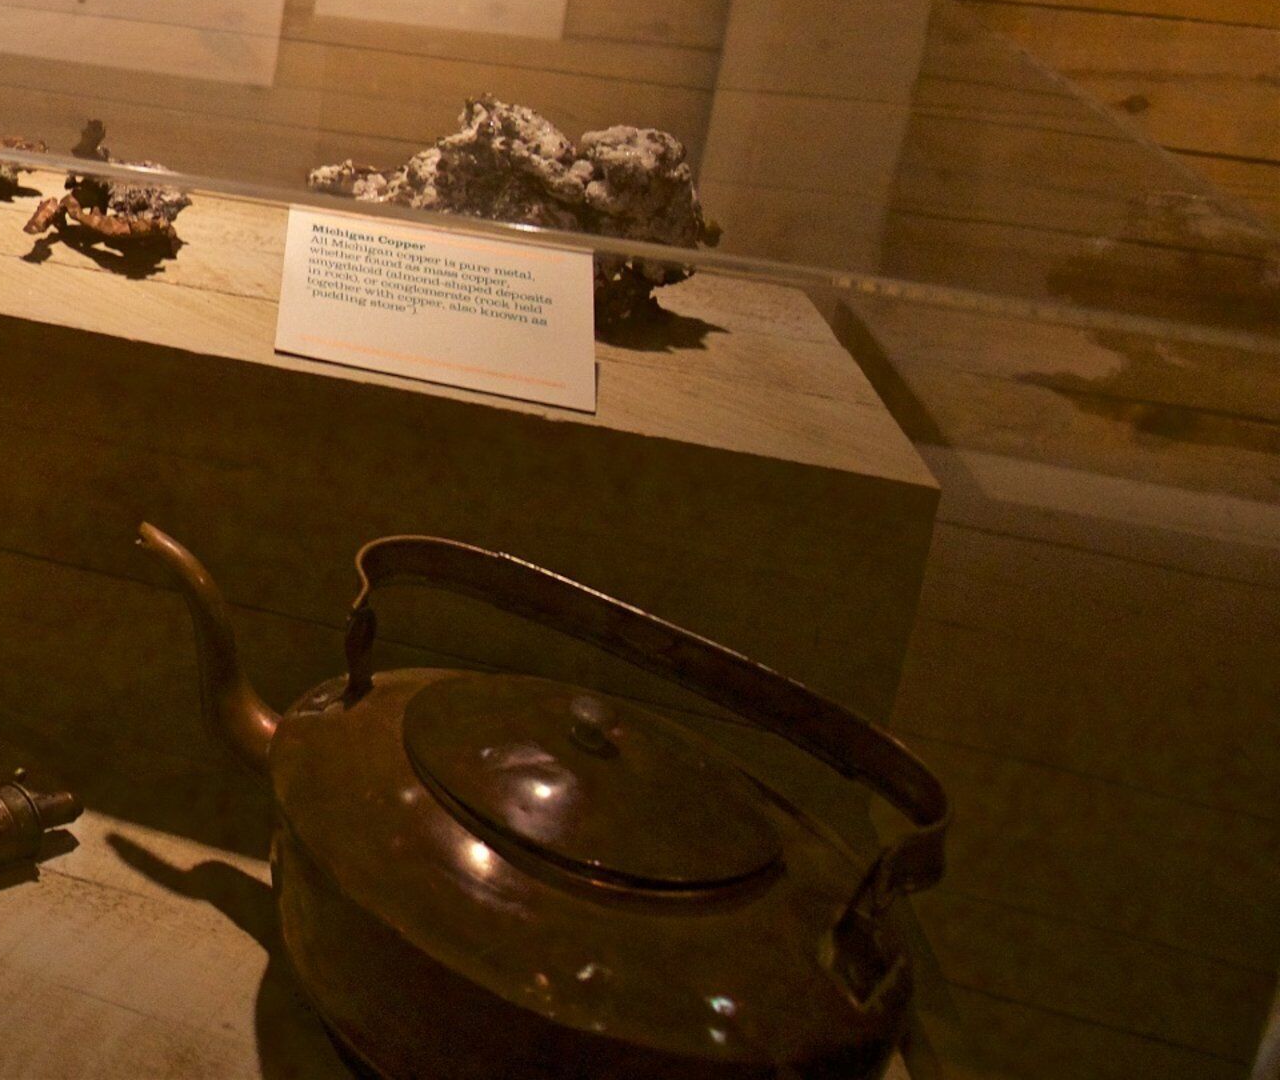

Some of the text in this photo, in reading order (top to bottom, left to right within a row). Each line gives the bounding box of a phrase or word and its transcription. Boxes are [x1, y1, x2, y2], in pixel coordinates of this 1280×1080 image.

[311, 235, 328, 246] All
[332, 238, 393, 257] Michigan
[397, 251, 441, 264] copper
[444, 258, 456, 267] is
[459, 261, 490, 274] pure
[312, 224, 426, 251] Michigan Copper
[308, 257, 382, 276] amygdaloid
[495, 288, 553, 305] deposits
[310, 246, 510, 289] whether found as mass copper,
[307, 276, 361, 293] together
[365, 287, 394, 300] with
[449, 302, 477, 314] also
[480, 306, 528, 323] known
[531, 317, 548, 326] as
[308, 266, 321, 276] in
[363, 277, 377, 286] or
[381, 279, 471, 301] conglomerate
[474, 295, 510, 310] (rock
[514, 302, 543, 315] held
